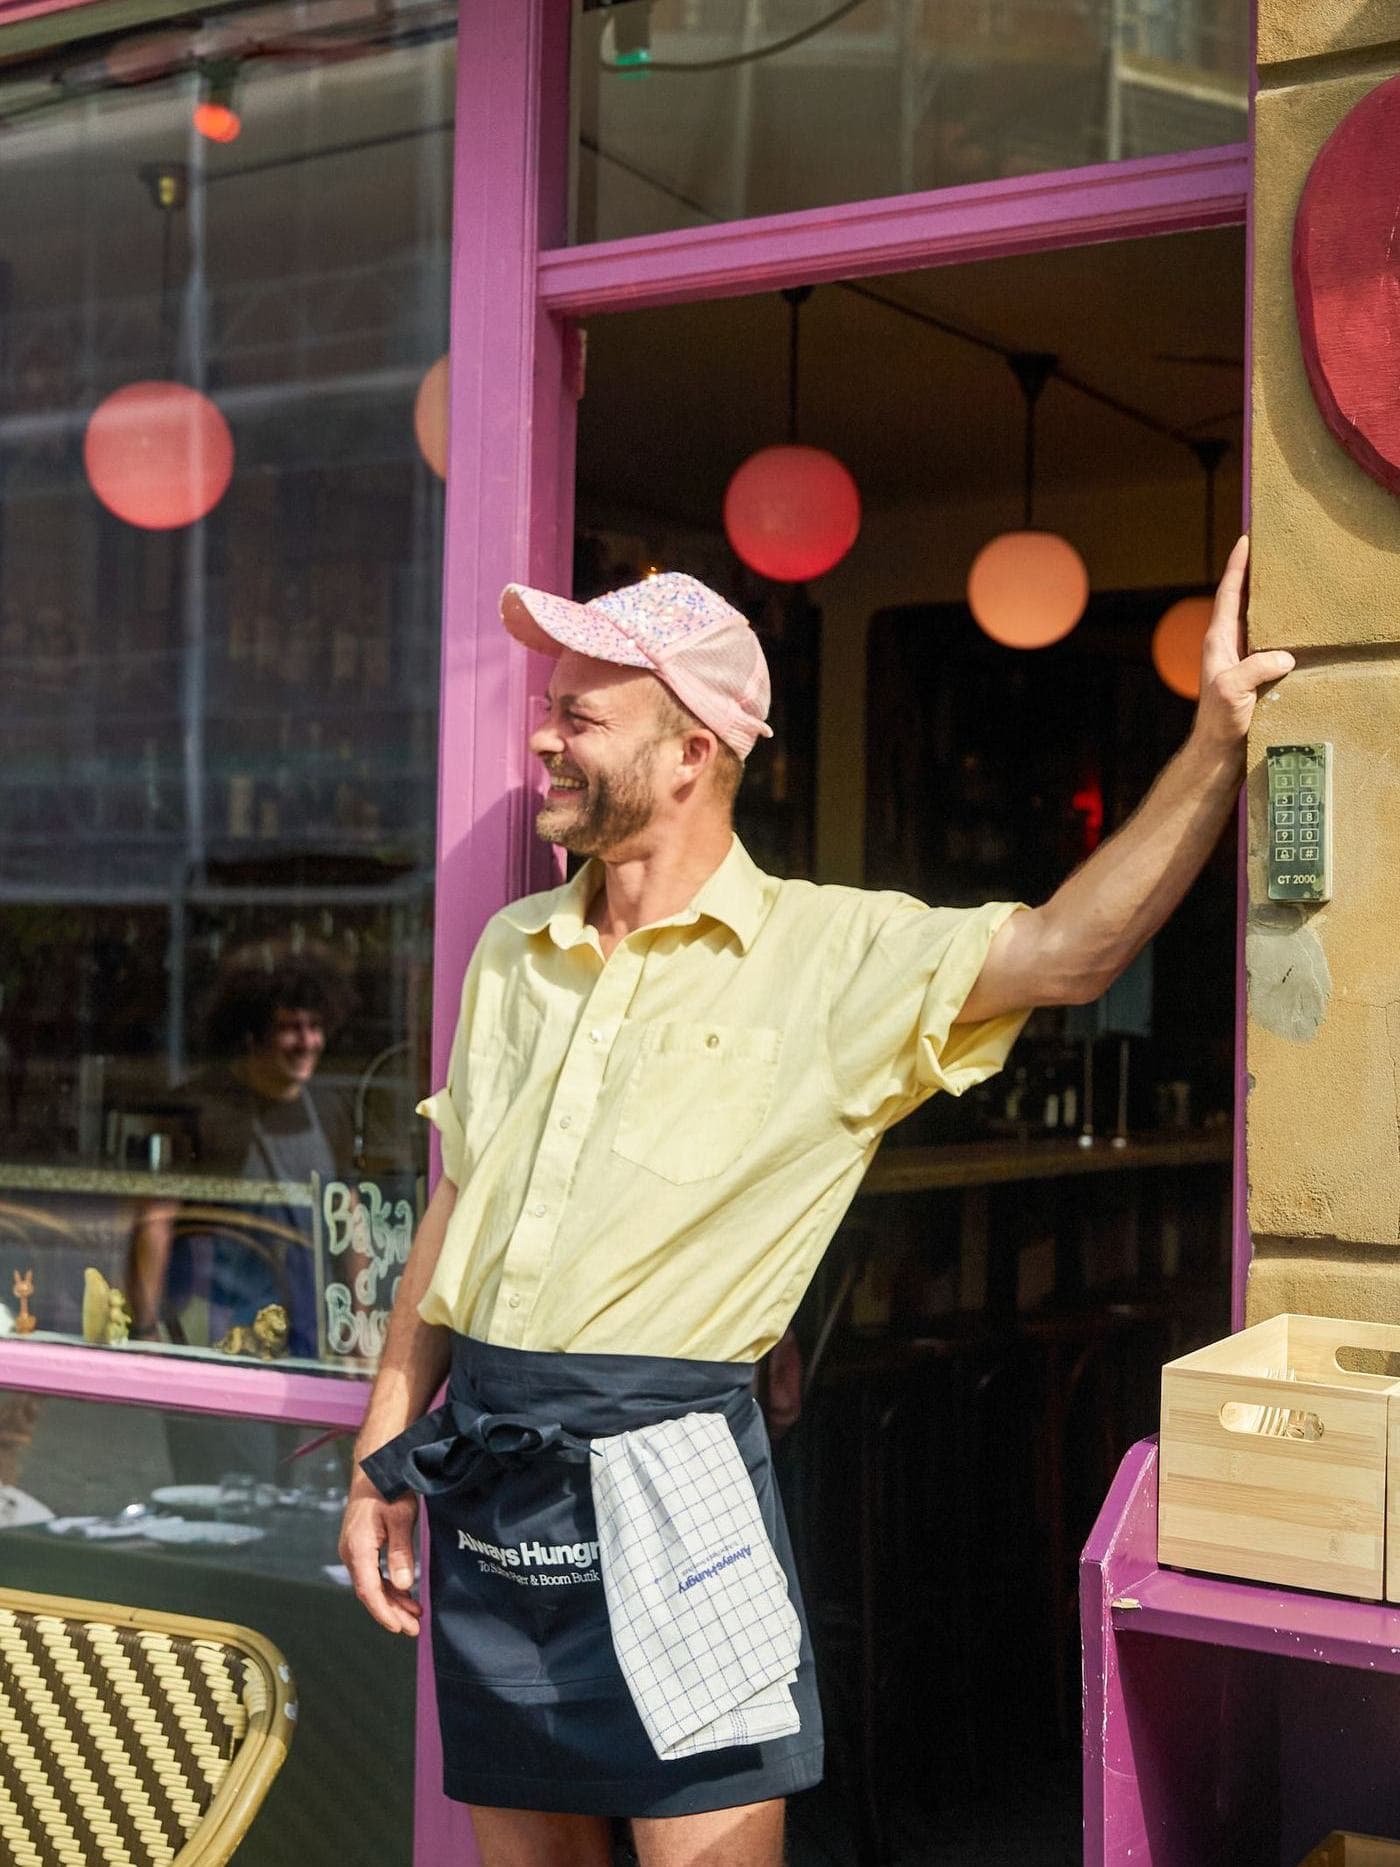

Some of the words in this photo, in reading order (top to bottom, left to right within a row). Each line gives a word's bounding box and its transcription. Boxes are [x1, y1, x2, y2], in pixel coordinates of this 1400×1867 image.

[1281, 777, 1288, 786] 3
[1305, 776, 1313, 784] 4
[1306, 794, 1313, 803] 6
[1281, 813, 1288, 822] 7
[1306, 812, 1313, 822] 8
[1282, 831, 1288, 840] 9
[1306, 830, 1313, 840] 0
[1305, 849, 1314, 858] #
[1277, 875, 1291, 885] CT
[1293, 874, 1317, 885] 2000
[325, 1276, 403, 1357] Bu
[529, 1574, 540, 1586] &
[540, 1574, 572, 1586] Boom
